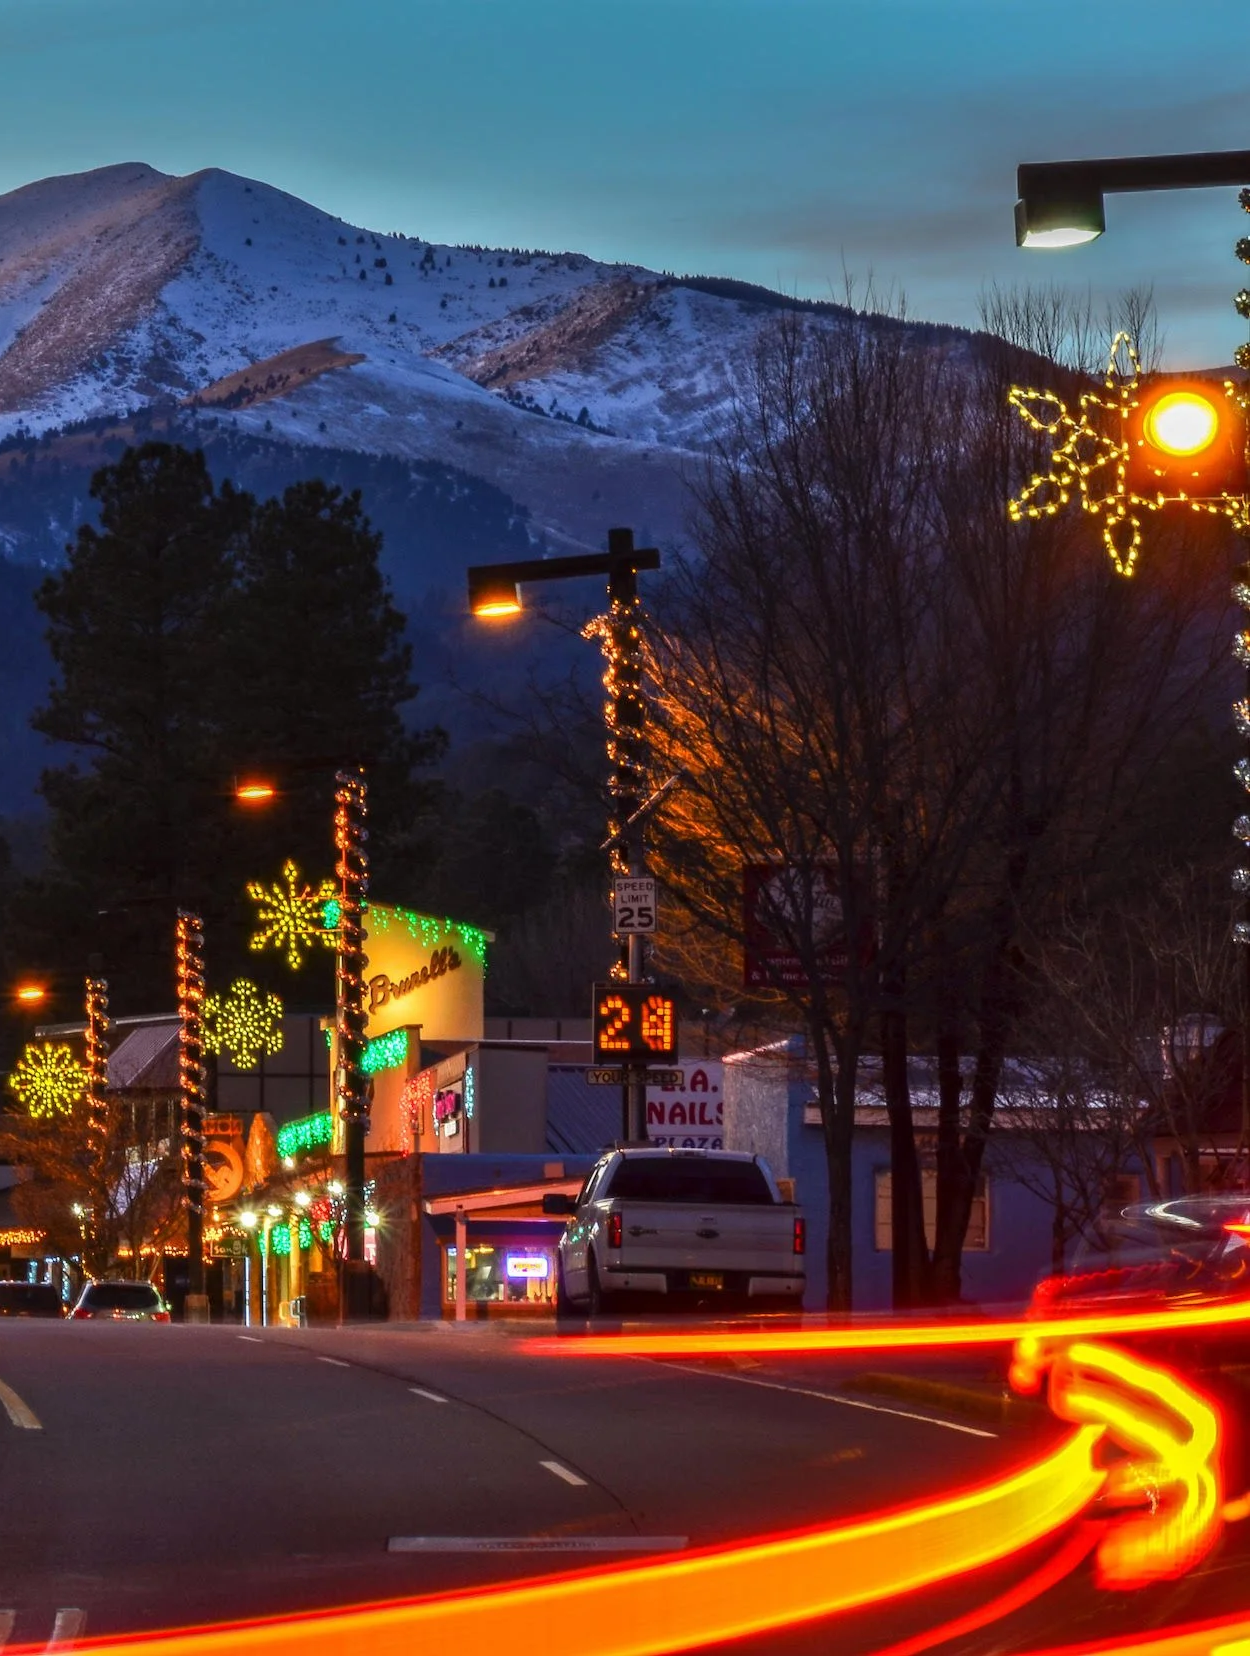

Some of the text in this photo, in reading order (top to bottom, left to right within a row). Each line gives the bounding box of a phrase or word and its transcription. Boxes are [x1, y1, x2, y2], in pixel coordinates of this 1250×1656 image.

[616, 882, 653, 891] SPEED
[620, 894, 649, 904] LIMIT
[618, 907, 653, 928] 25
[368, 946, 462, 1015] Brunell's
[593, 1072, 679, 1083] YOUR SPEED
[661, 1069, 718, 1092] .A.
